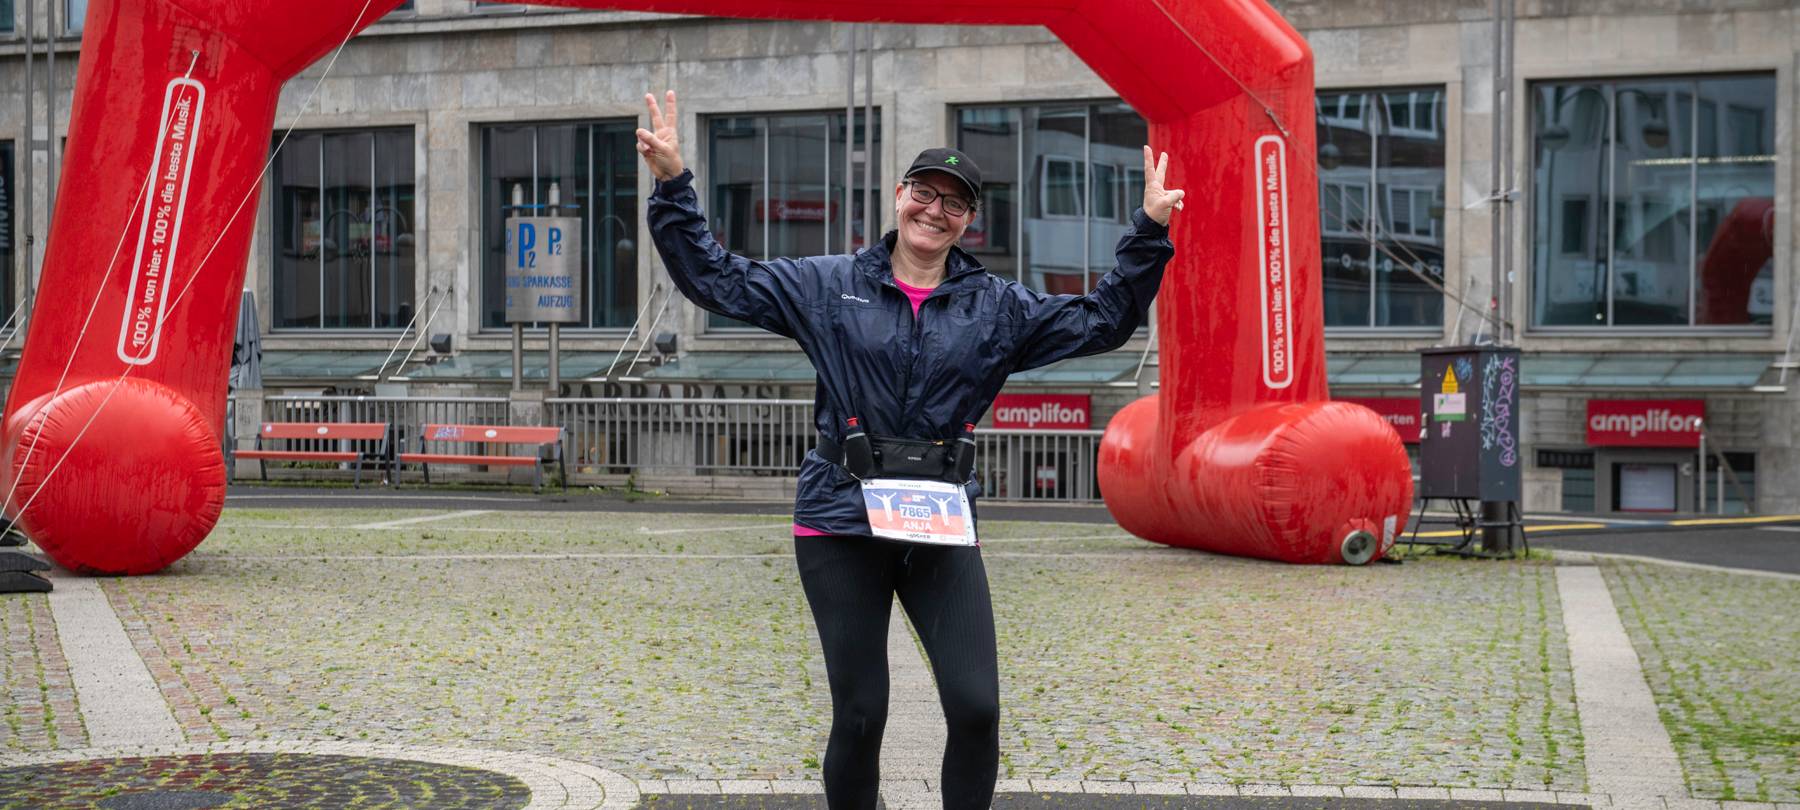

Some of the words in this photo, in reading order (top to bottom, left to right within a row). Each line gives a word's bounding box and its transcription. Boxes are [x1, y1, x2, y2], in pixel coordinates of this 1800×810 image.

[172, 95, 191, 141] Musik.
[164, 142, 182, 182] beste
[1266, 150, 1278, 190] Musik.
[160, 183, 175, 203] die
[1268, 192, 1279, 226] beste
[152, 204, 172, 247] 100%
[1269, 227, 1280, 246] die
[145, 248, 162, 277] hier.
[1269, 247, 1281, 285] 100%
[143, 279, 157, 303] von
[523, 276, 573, 288] SPARKASSE
[538, 295, 574, 308] AUFZUG
[1271, 286, 1283, 311] hier.
[132, 306, 152, 349] 100%
[1273, 313, 1283, 335] von
[1273, 337, 1284, 374] 100%
[996, 402, 1086, 427] amplifon
[1590, 408, 1699, 437] amplifon
[901, 505, 931, 519] 7865
[903, 520, 934, 531] ANJA
